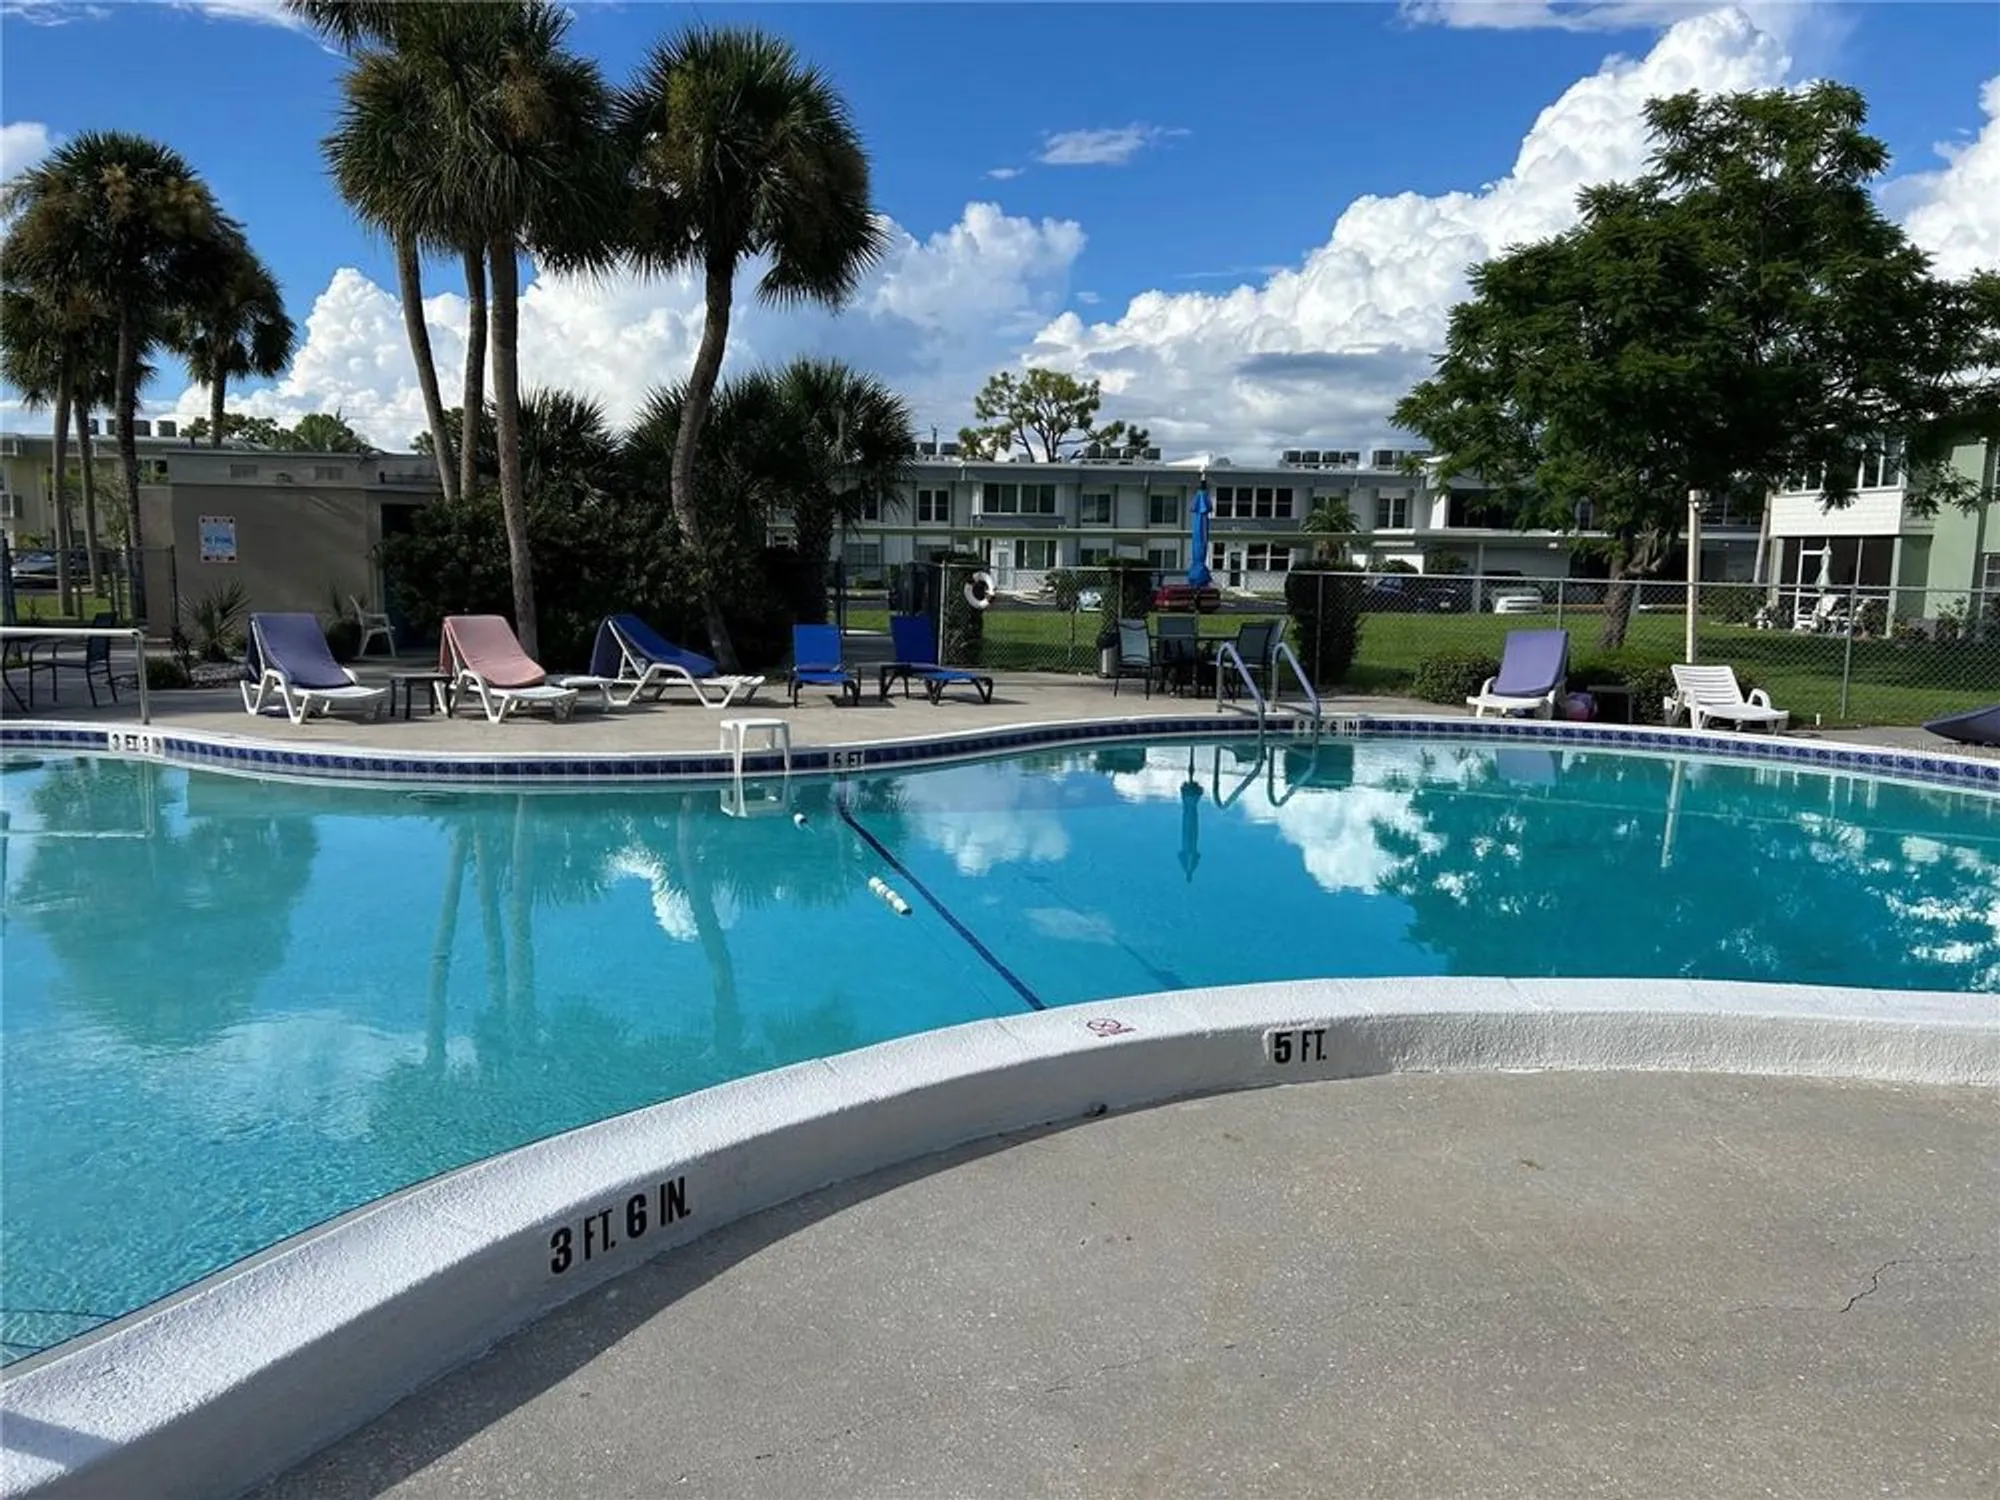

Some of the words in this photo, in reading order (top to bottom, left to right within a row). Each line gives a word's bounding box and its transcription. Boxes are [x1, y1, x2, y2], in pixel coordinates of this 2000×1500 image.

[847, 750, 863, 767] FT
[1274, 1031, 1292, 1065] 5
[1301, 1029, 1327, 1063] FT.
[551, 1227, 572, 1274] 3
[584, 1208, 616, 1261] FT.
[626, 1193, 647, 1239] 6
[660, 1176, 691, 1226] IN.
